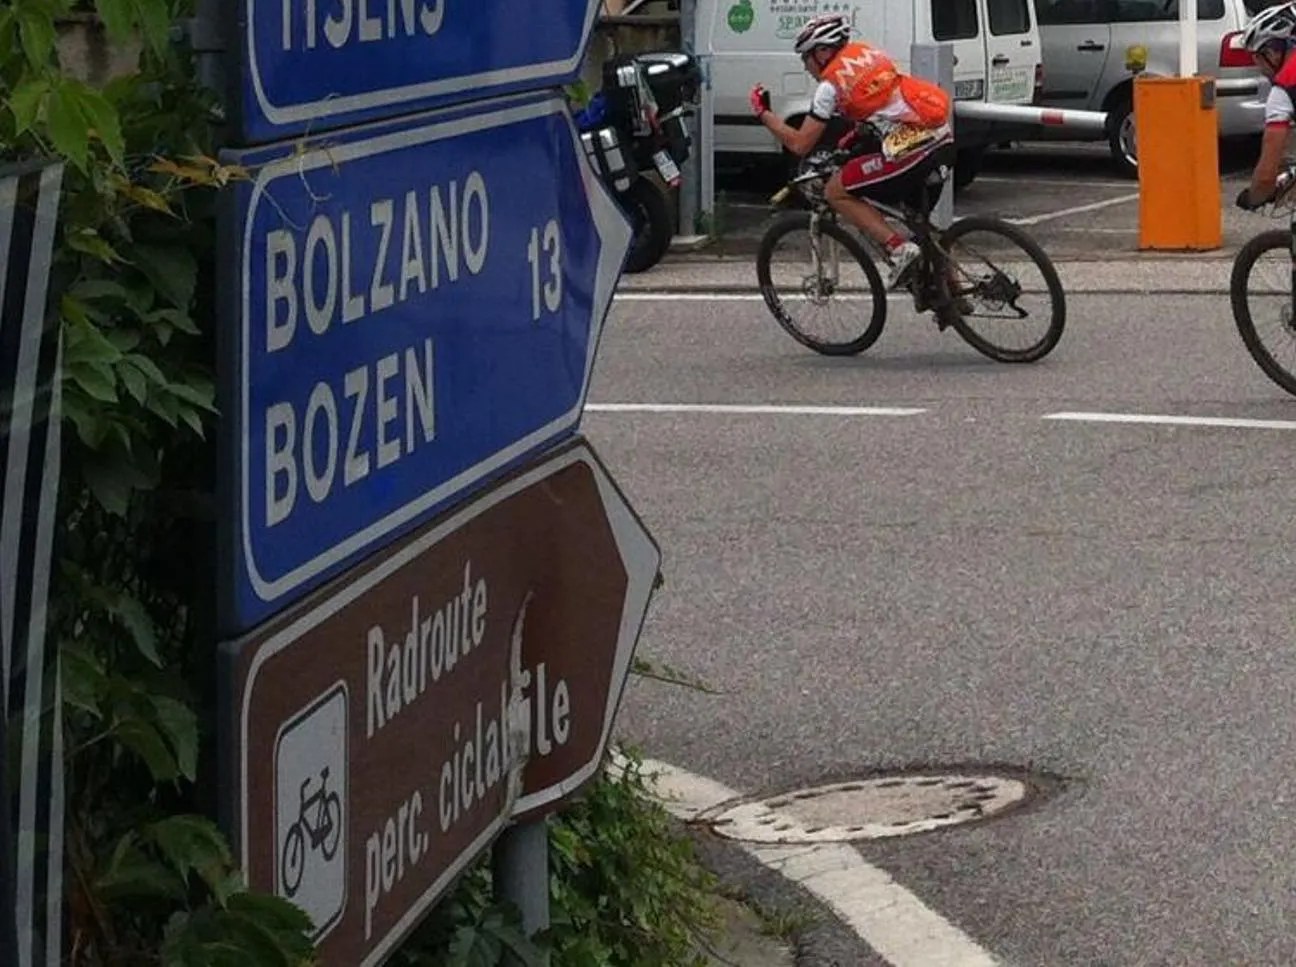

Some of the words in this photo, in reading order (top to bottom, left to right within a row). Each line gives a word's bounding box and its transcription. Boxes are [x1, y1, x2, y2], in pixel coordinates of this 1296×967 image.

[266, 170, 490, 353] BOLZANO
[528, 219, 562, 320] 13
[265, 337, 436, 527] BOZEN
[366, 559, 488, 740] Radroute
[364, 789, 429, 941] perc.
